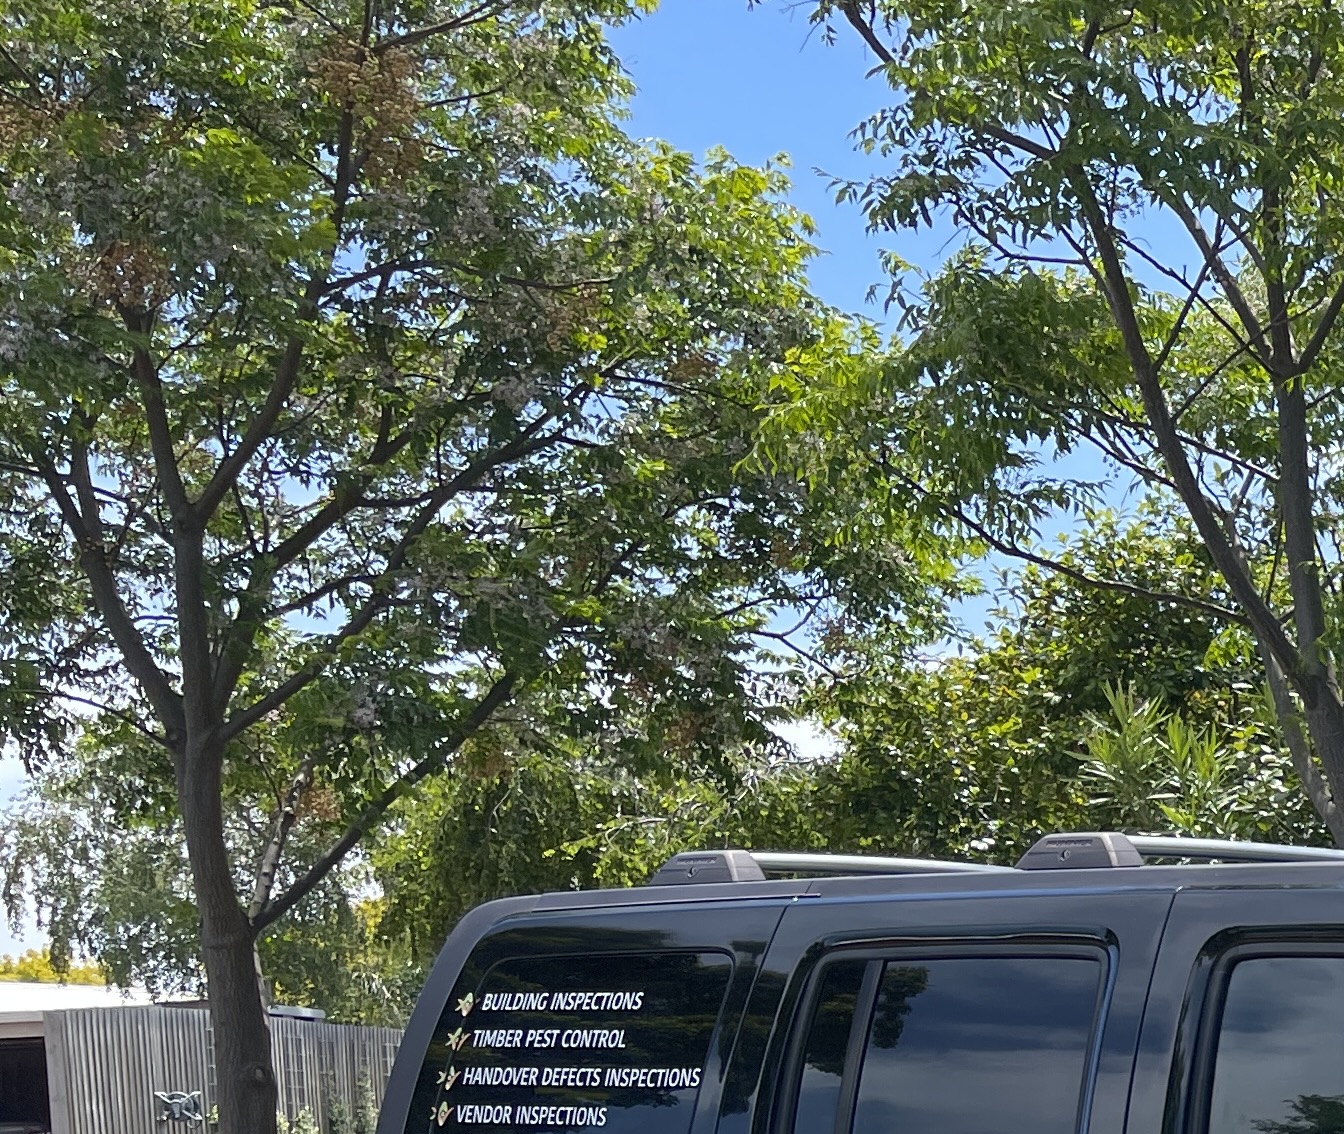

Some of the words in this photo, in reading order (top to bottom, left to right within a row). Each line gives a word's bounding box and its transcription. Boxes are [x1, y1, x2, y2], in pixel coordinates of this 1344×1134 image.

[481, 992, 550, 1011] BUILDING
[549, 991, 645, 1011] INSPECTIONS
[472, 1029, 524, 1048] TIMBER
[524, 1029, 561, 1048] PEST
[561, 1029, 626, 1049] CONTROL
[462, 1067, 539, 1086] HANDOVER
[541, 1067, 602, 1087] DEFECTS
[603, 1068, 702, 1088] INSPECTIONS
[457, 1104, 513, 1124] VENDOR
[515, 1105, 608, 1127] INSPECTIONS
